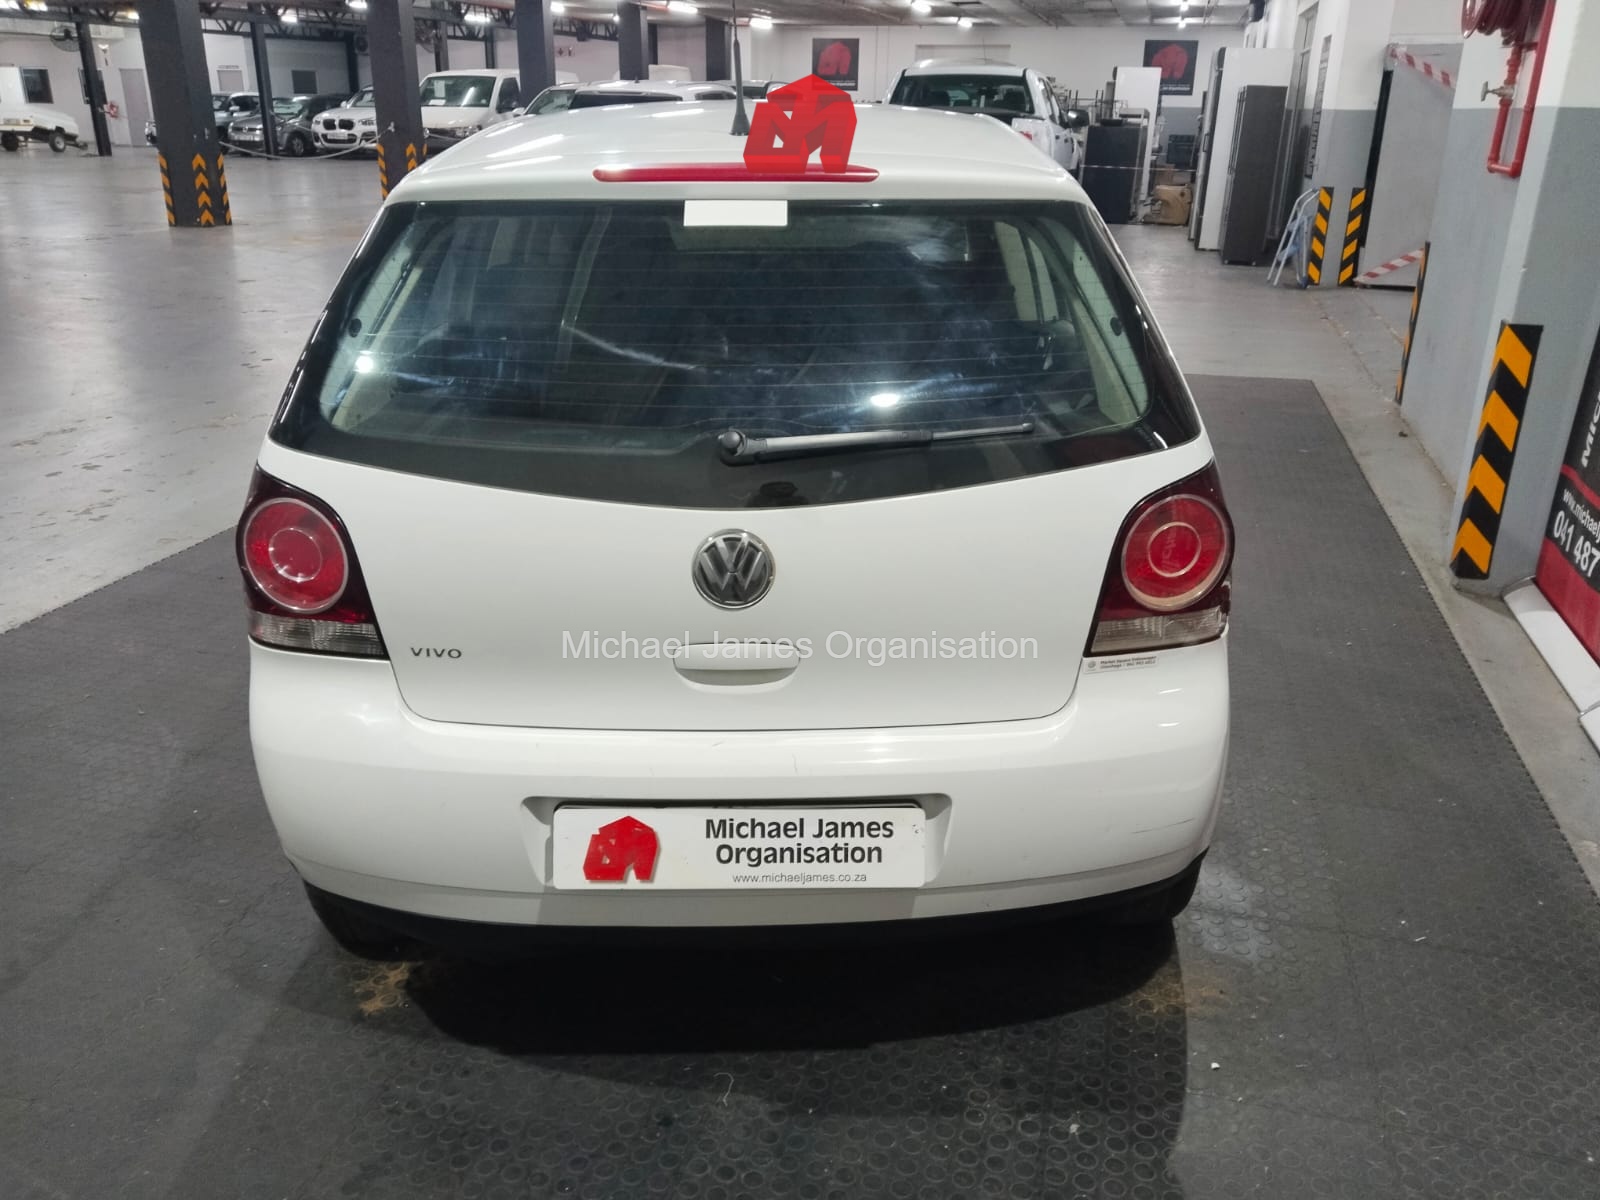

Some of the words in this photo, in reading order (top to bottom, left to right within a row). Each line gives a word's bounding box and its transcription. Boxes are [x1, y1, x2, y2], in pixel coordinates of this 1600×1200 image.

[1553, 510, 1575, 552] 041
[1573, 535, 1600, 577] 487
[410, 647, 462, 659] VIVO
[705, 818, 805, 839] Michael
[812, 818, 894, 839] James
[716, 843, 882, 868] Organisation
[732, 872, 867, 885] www.michaeljames.co.za
